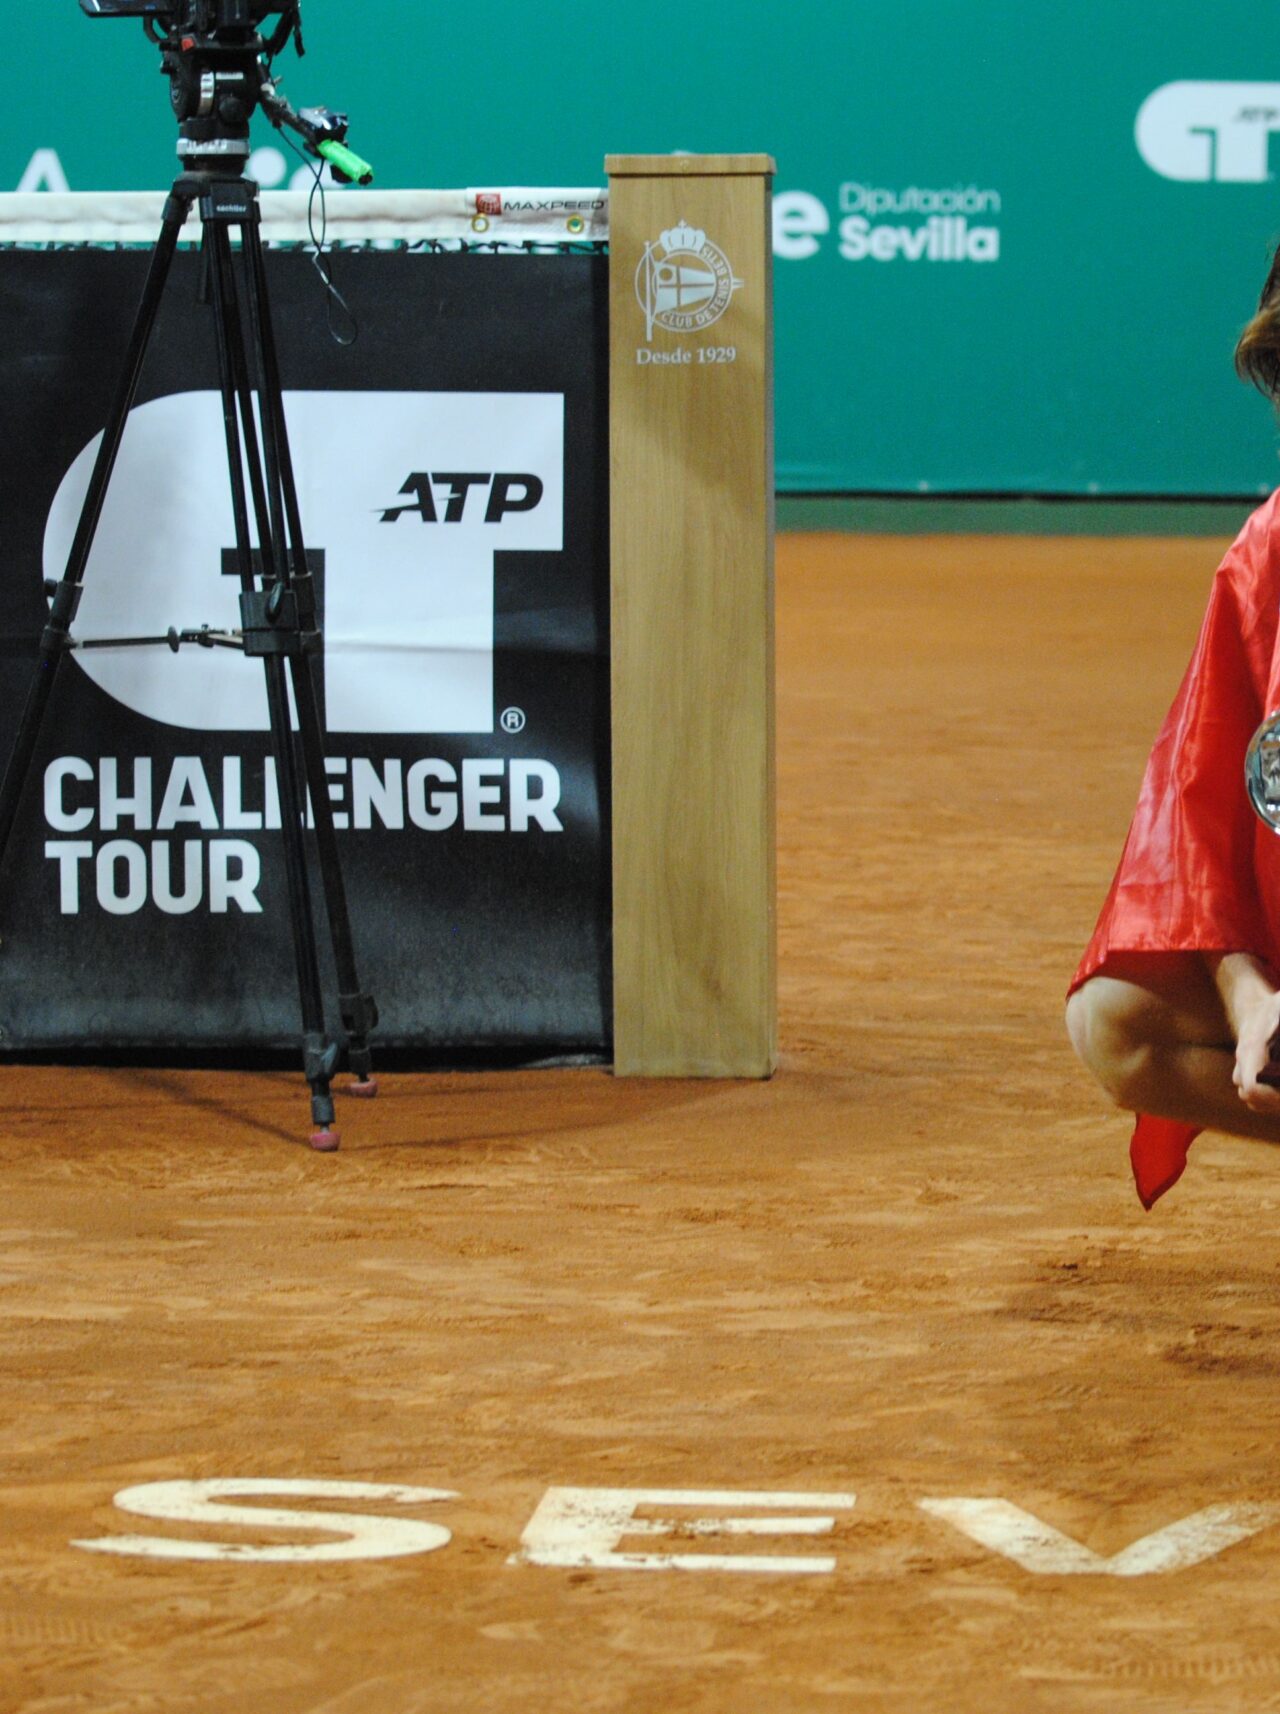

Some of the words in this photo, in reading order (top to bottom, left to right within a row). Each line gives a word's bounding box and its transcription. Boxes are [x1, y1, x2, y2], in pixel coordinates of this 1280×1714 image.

[503, 200, 604, 211] MAXPEED
[839, 215, 1000, 262] Sevilla
[702, 245, 728, 277] BETIS
[711, 278, 730, 313] TENIS
[661, 312, 693, 328] CLUB
[695, 310, 713, 325] DE
[636, 347, 692, 365] Desde
[697, 346, 736, 363] 1929
[370, 471, 544, 523] ATP
[44, 840, 263, 915] TOUR
